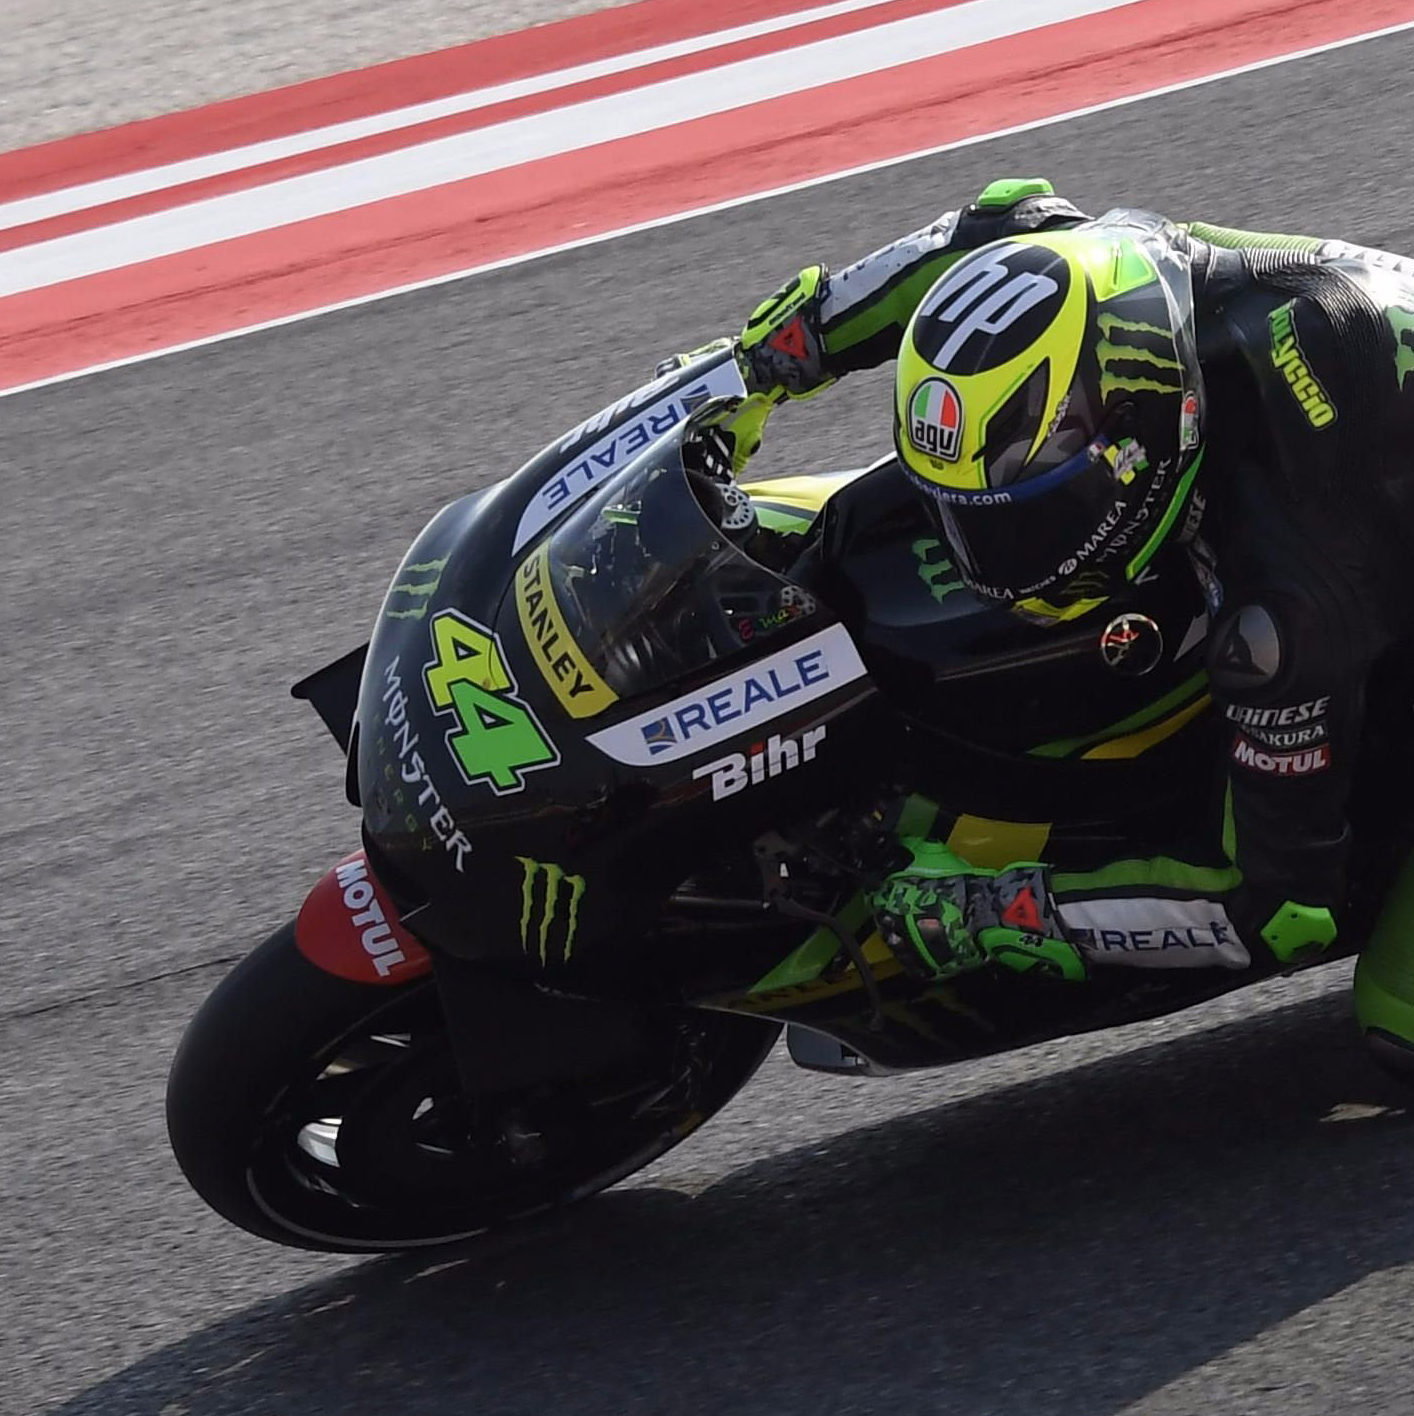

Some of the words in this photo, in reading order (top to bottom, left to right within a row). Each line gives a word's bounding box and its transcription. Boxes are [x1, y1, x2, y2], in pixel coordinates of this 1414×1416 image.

[920, 242, 1058, 370] hp
[542, 403, 681, 511] REALE
[915, 419, 954, 453] agv
[1076, 500, 1128, 561] MAREA
[522, 555, 594, 699] STANLEY
[422, 608, 560, 796] 44
[677, 650, 830, 741] REALE
[382, 655, 473, 873] MONSTER
[692, 725, 826, 801] Bihr
[1234, 740, 1327, 773] MOTUL
[335, 859, 405, 977] MOTUL
